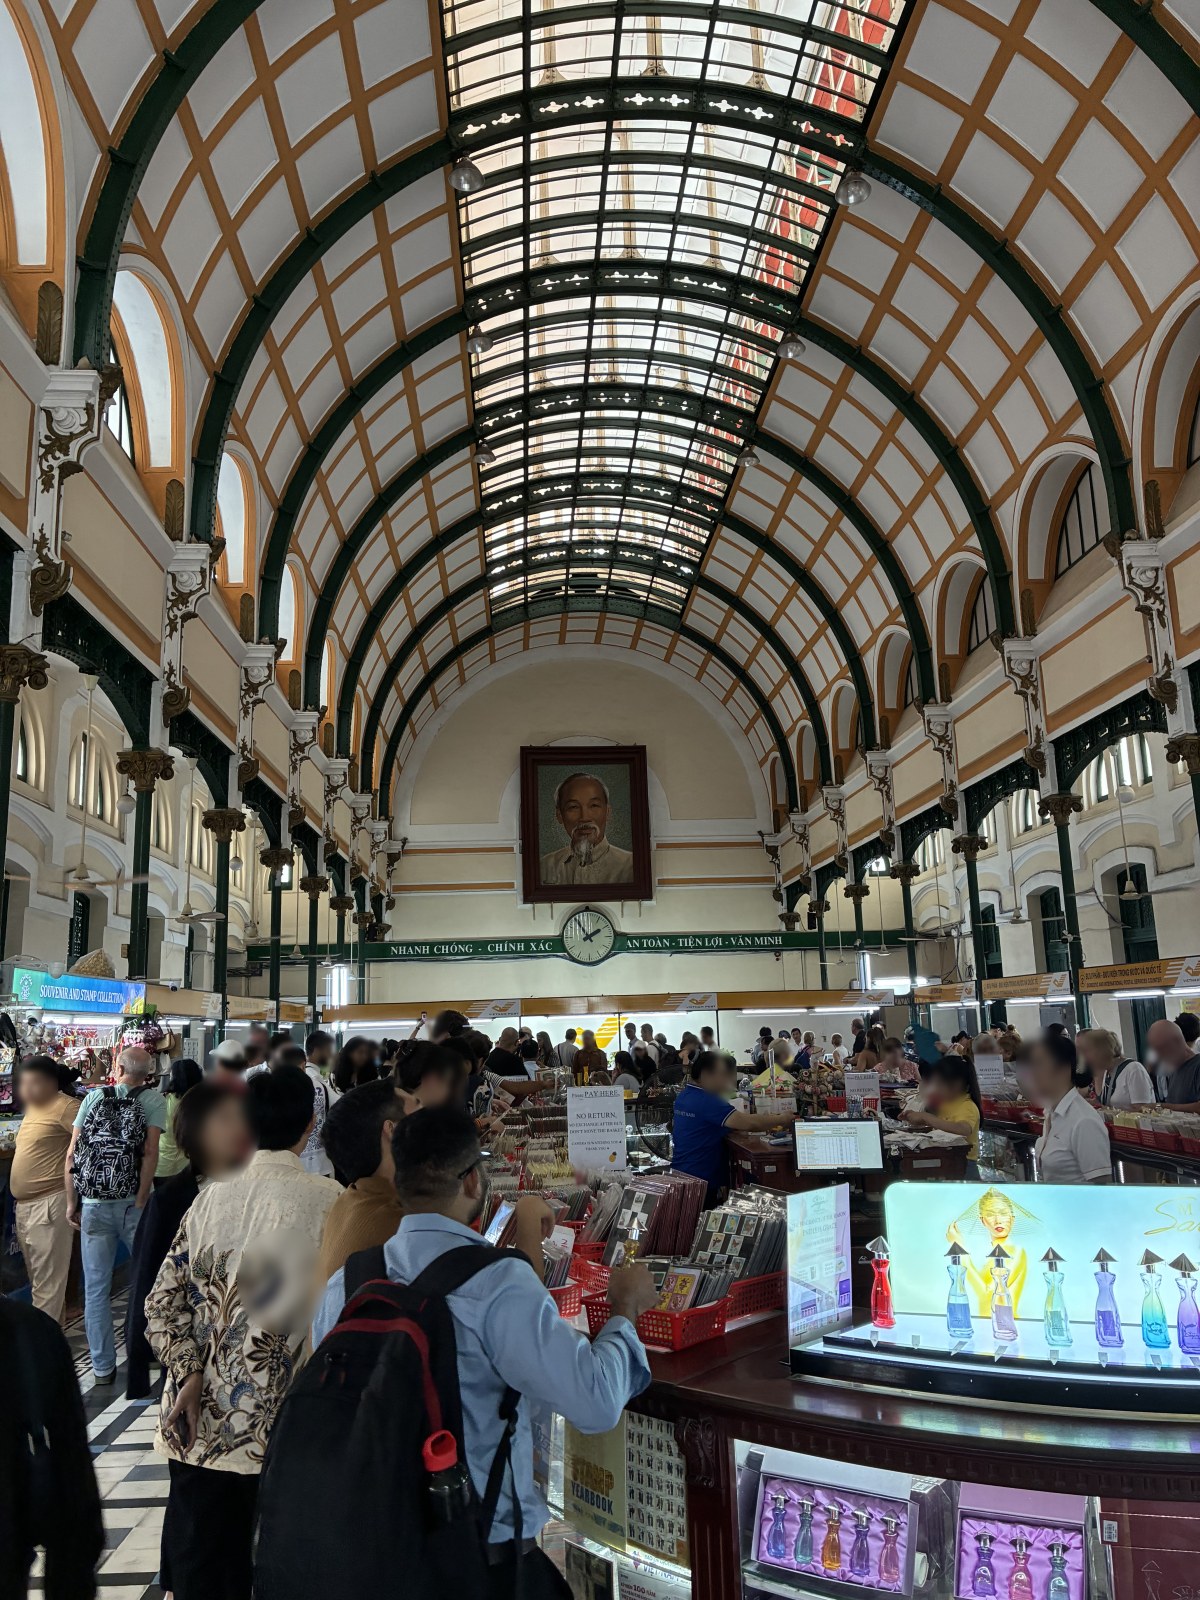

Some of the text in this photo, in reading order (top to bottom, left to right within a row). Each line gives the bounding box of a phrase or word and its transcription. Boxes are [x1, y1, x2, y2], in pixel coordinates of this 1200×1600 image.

[390, 945, 430, 955] NHANH
[434, 943, 473, 954] CHÓNG
[487, 942, 525, 953] CHÍNH
[529, 941, 553, 951] XÁC
[626, 938, 640, 948] AN
[642, 936, 670, 947] TOÀN
[677, 935, 703, 949] TIỆN
[705, 936, 723, 949] LỢI
[730, 934, 751, 947] VĂN
[754, 936, 783, 946] MINH
[40, 984, 124, 1004] SOUVENIR AND STAMP COLLECTION
[571, 1480, 614, 1516] YEARBOOK
